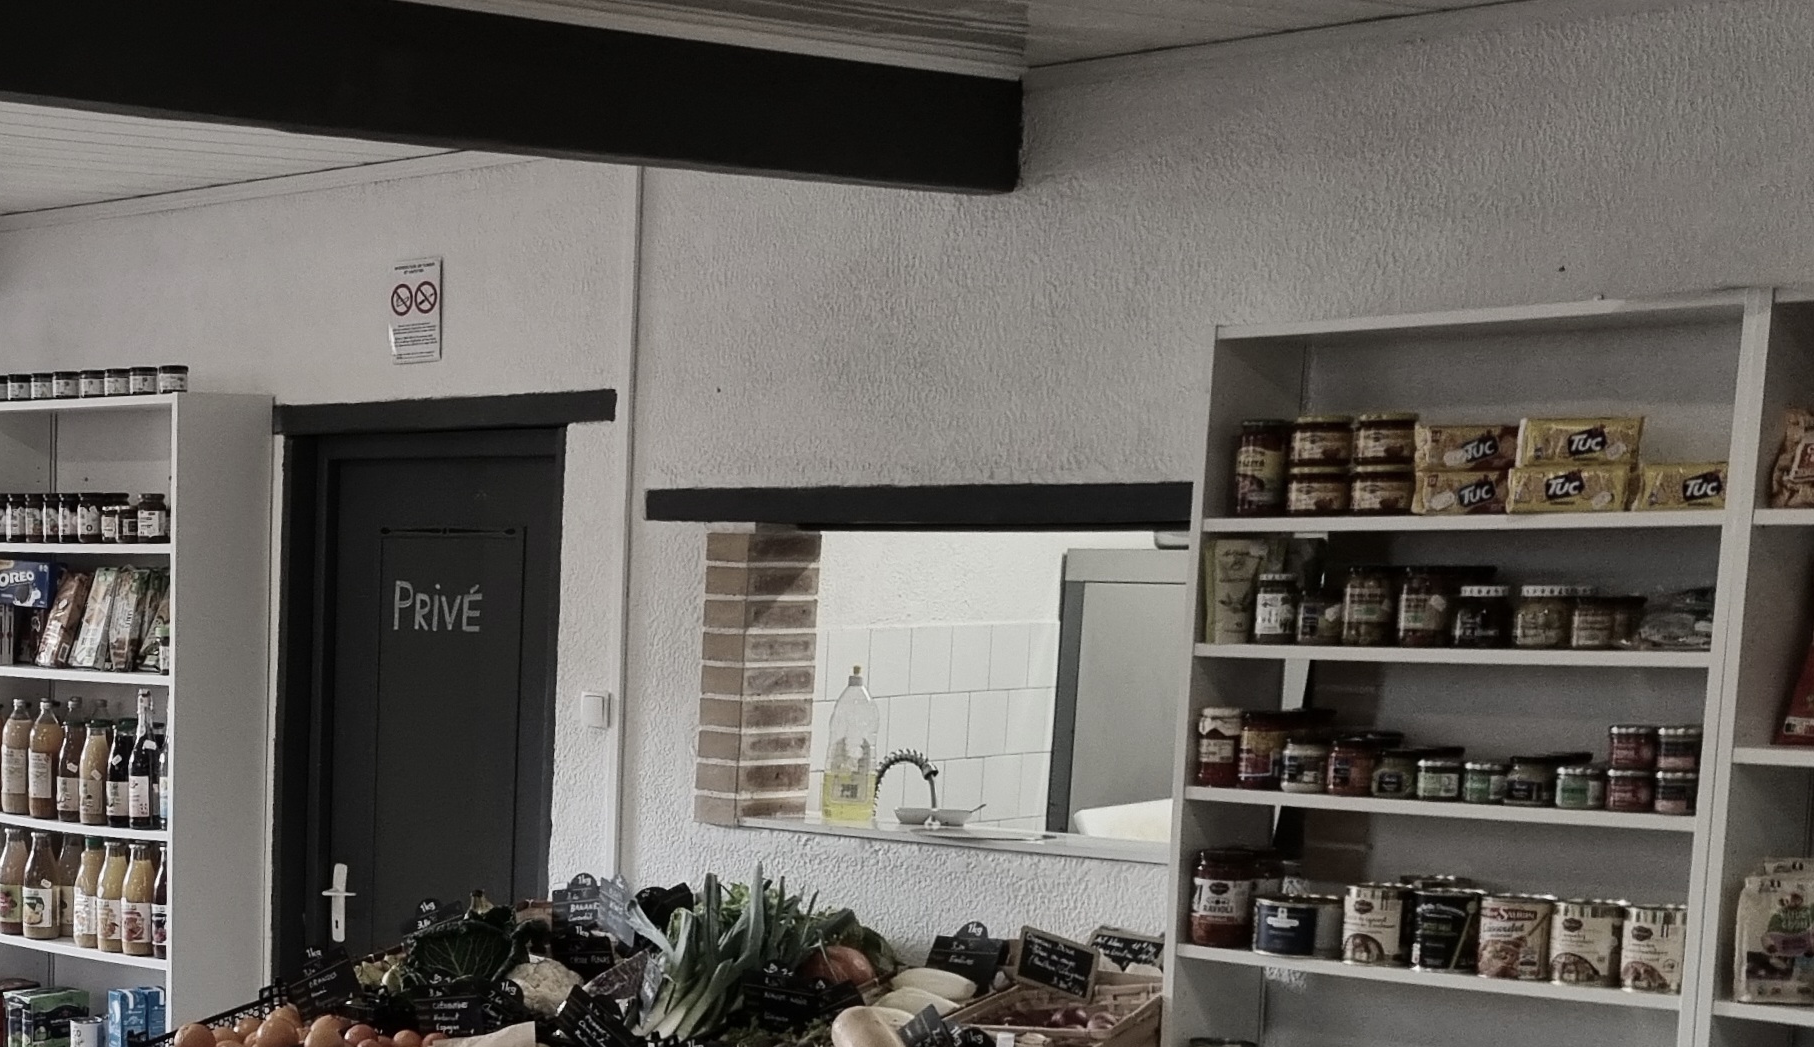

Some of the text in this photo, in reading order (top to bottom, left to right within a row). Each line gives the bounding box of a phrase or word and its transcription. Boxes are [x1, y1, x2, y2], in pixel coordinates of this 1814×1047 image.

[1571, 432, 1603, 452] TUC
[1460, 484, 1493, 503] TUC
[1546, 477, 1581, 496] TUC
[1685, 478, 1719, 497] TUC
[577, 875, 591, 886] 1kg
[419, 901, 436, 913] 1kg
[967, 922, 984, 937] 1kg
[305, 948, 323, 959] 1kg
[500, 981, 517, 996] 1kg
